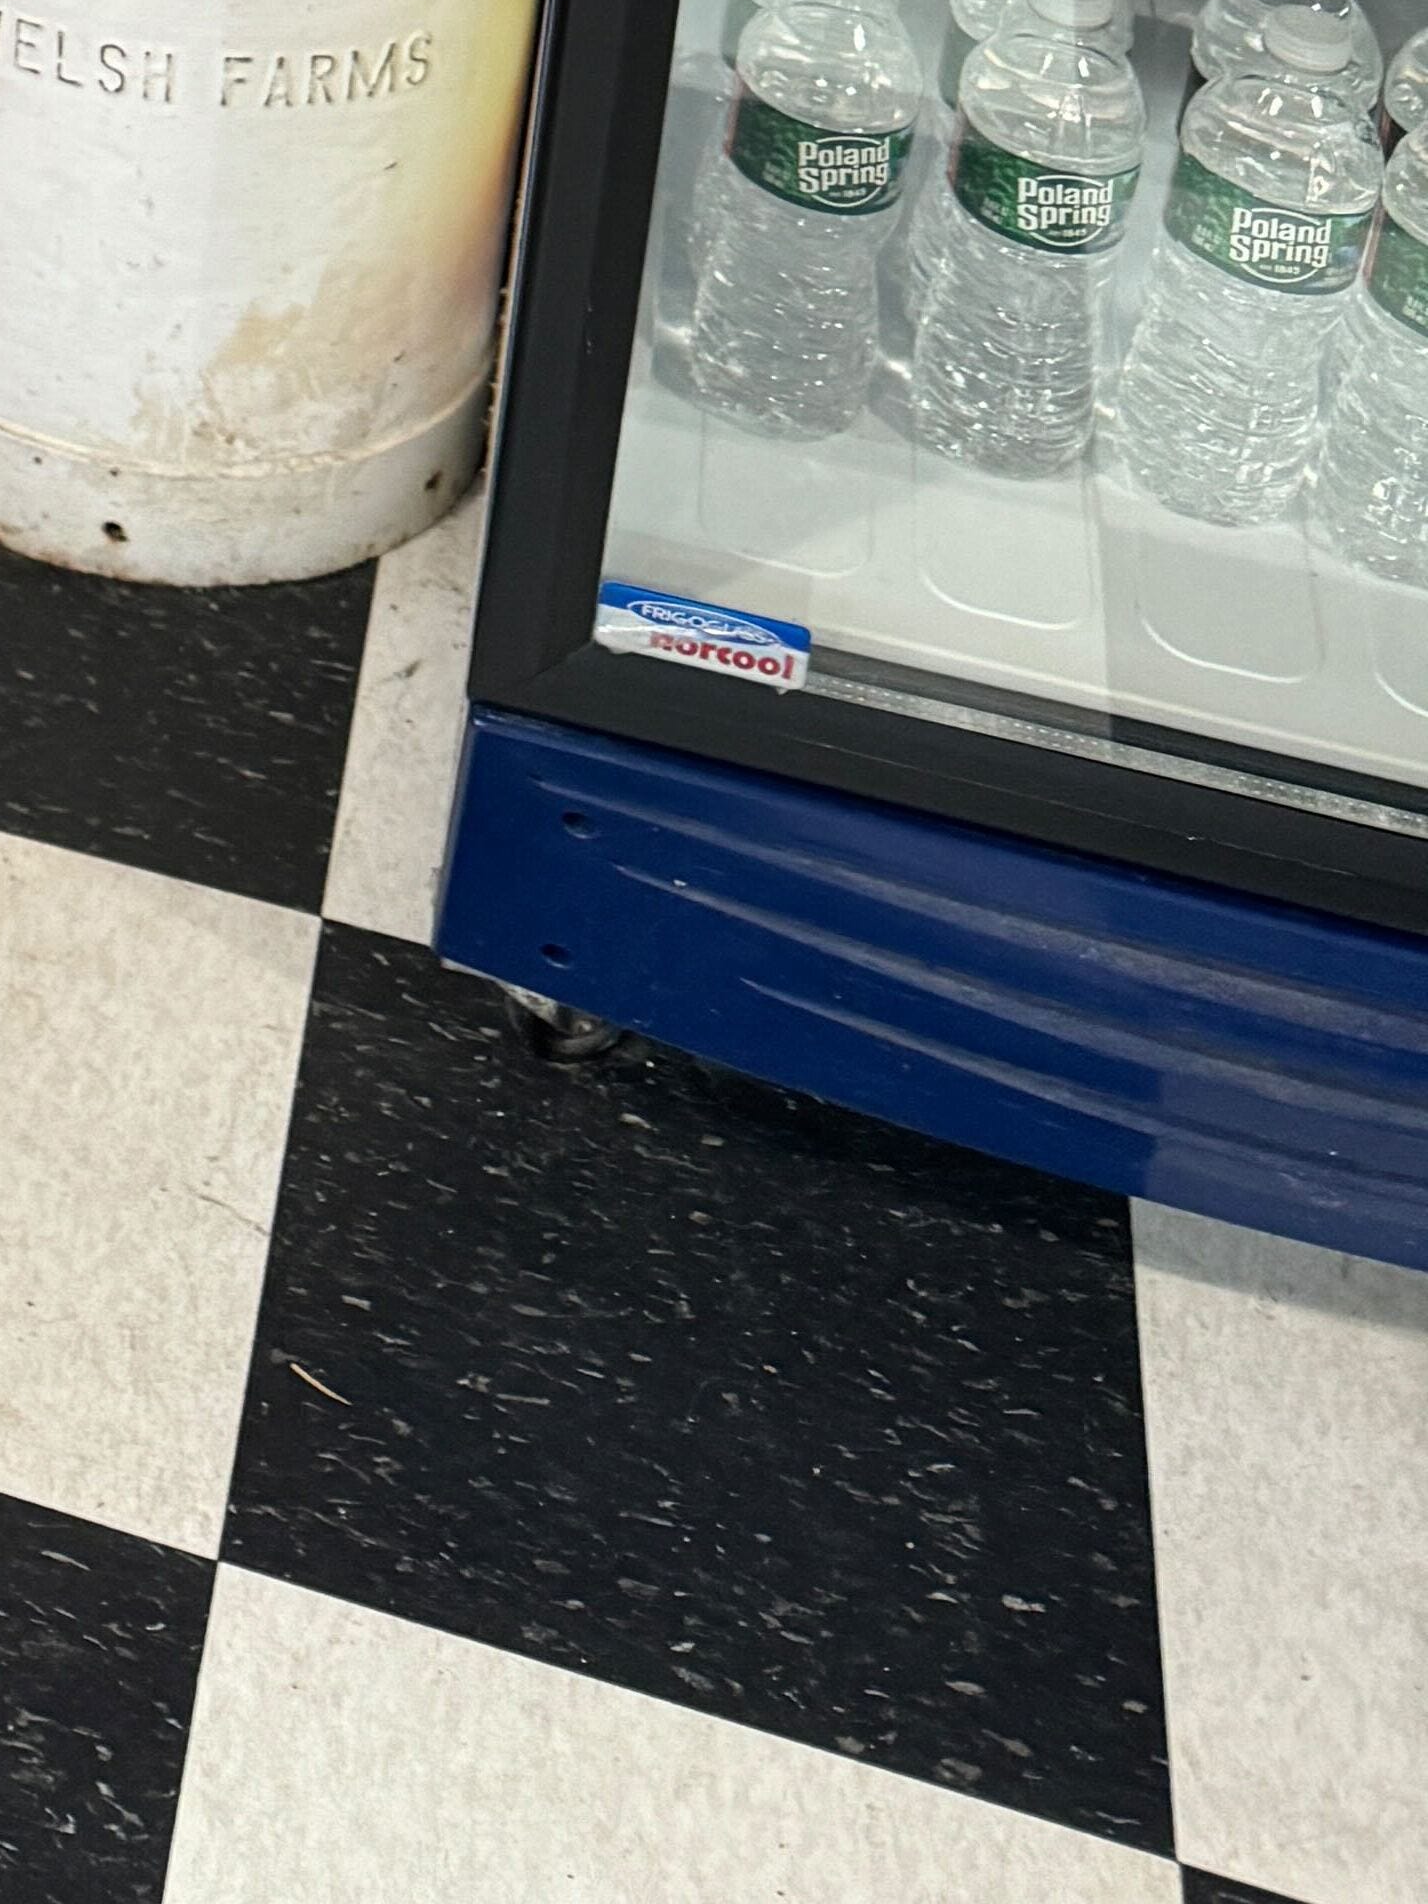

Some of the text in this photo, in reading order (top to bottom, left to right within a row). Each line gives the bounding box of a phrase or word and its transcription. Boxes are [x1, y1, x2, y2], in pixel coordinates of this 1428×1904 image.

[220, 28, 434, 108] FARMS
[797, 136, 891, 168] Poland
[797, 162, 888, 194] Spring
[1017, 177, 1114, 206] Poland
[1016, 201, 1112, 232] Spring
[1232, 206, 1332, 245] Poland
[1229, 233, 1329, 269] Spring
[648, 630, 795, 680] norcool
